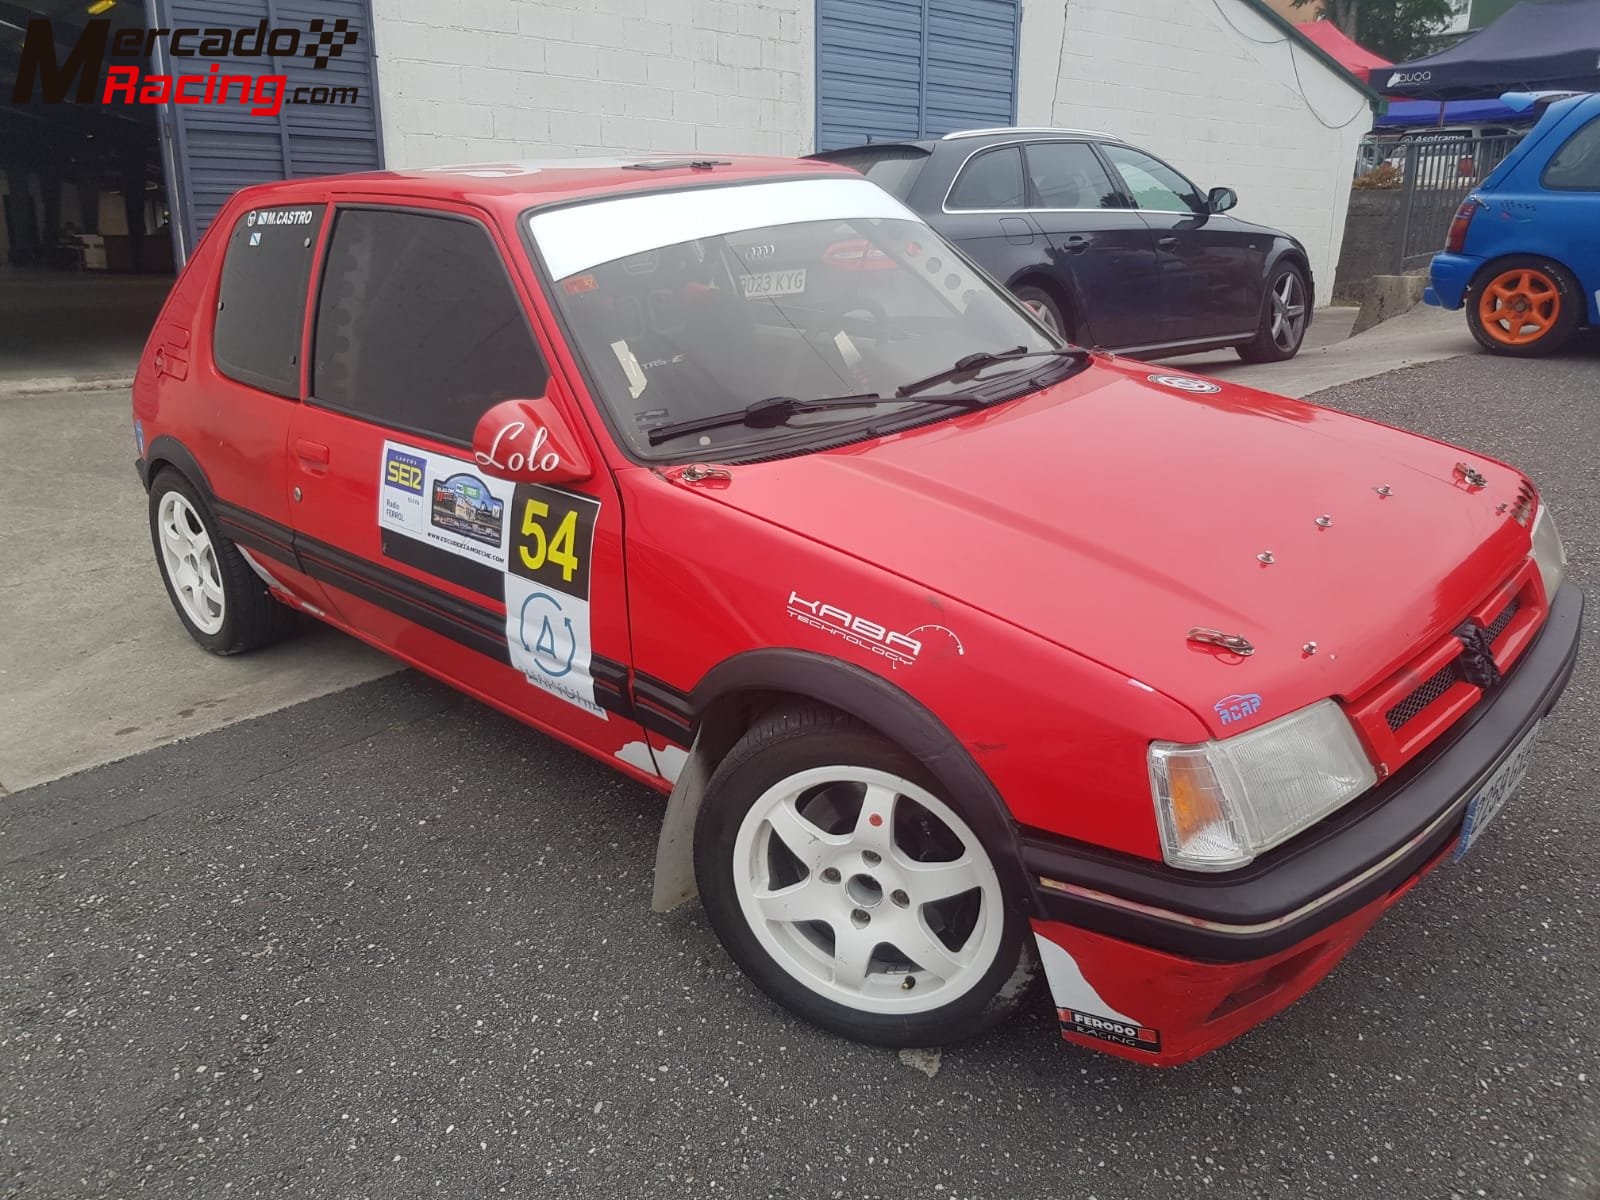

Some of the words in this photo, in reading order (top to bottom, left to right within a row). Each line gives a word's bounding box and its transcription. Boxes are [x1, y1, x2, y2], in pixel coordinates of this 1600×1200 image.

[267, 210, 313, 225] M.CASTRO
[775, 270, 804, 291] KYG
[474, 421, 560, 472] Lolo
[387, 460, 422, 490] SER
[519, 498, 578, 582] 54
[788, 590, 922, 656] KABA
[786, 609, 913, 670] TECHNOLOGY
[1074, 1012, 1137, 1037] FERODO
[1076, 1025, 1136, 1047] RACING
